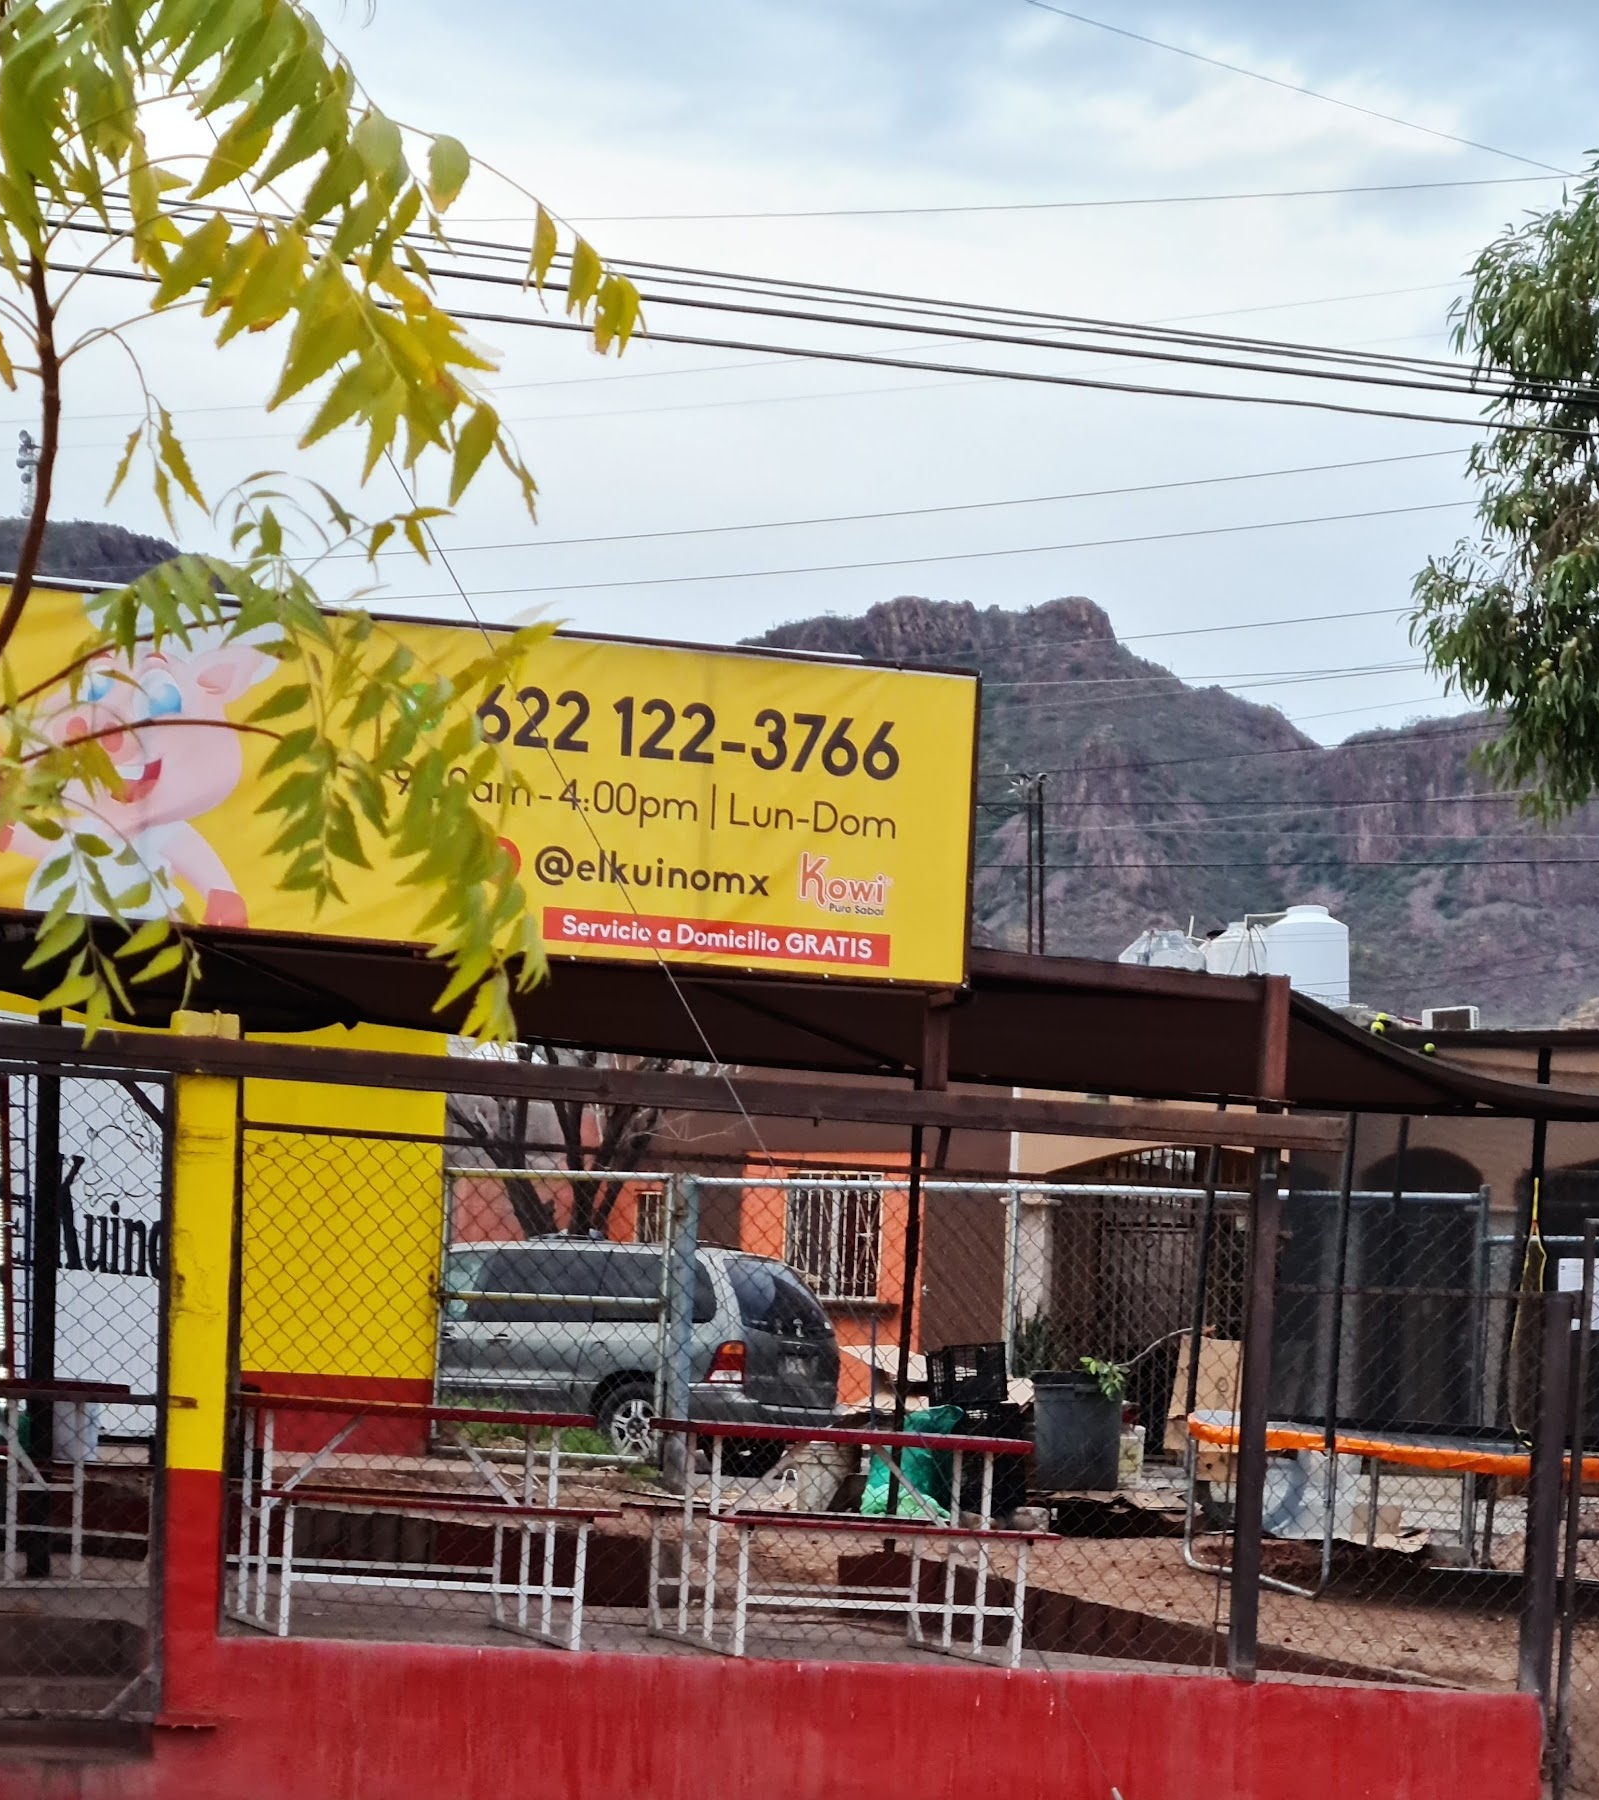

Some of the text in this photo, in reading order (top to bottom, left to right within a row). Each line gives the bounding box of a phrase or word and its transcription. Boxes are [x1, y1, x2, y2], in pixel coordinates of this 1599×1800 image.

[476, 683, 901, 781] 622 122-3766
[729, 793, 896, 839] Lun-Dom
[534, 845, 770, 897] @elkuinomx
[799, 850, 885, 908] Kowi
[829, 902, 885, 917] Puro Sabor
[561, 913, 873, 960] Servicio a Domicilio GRATIS
